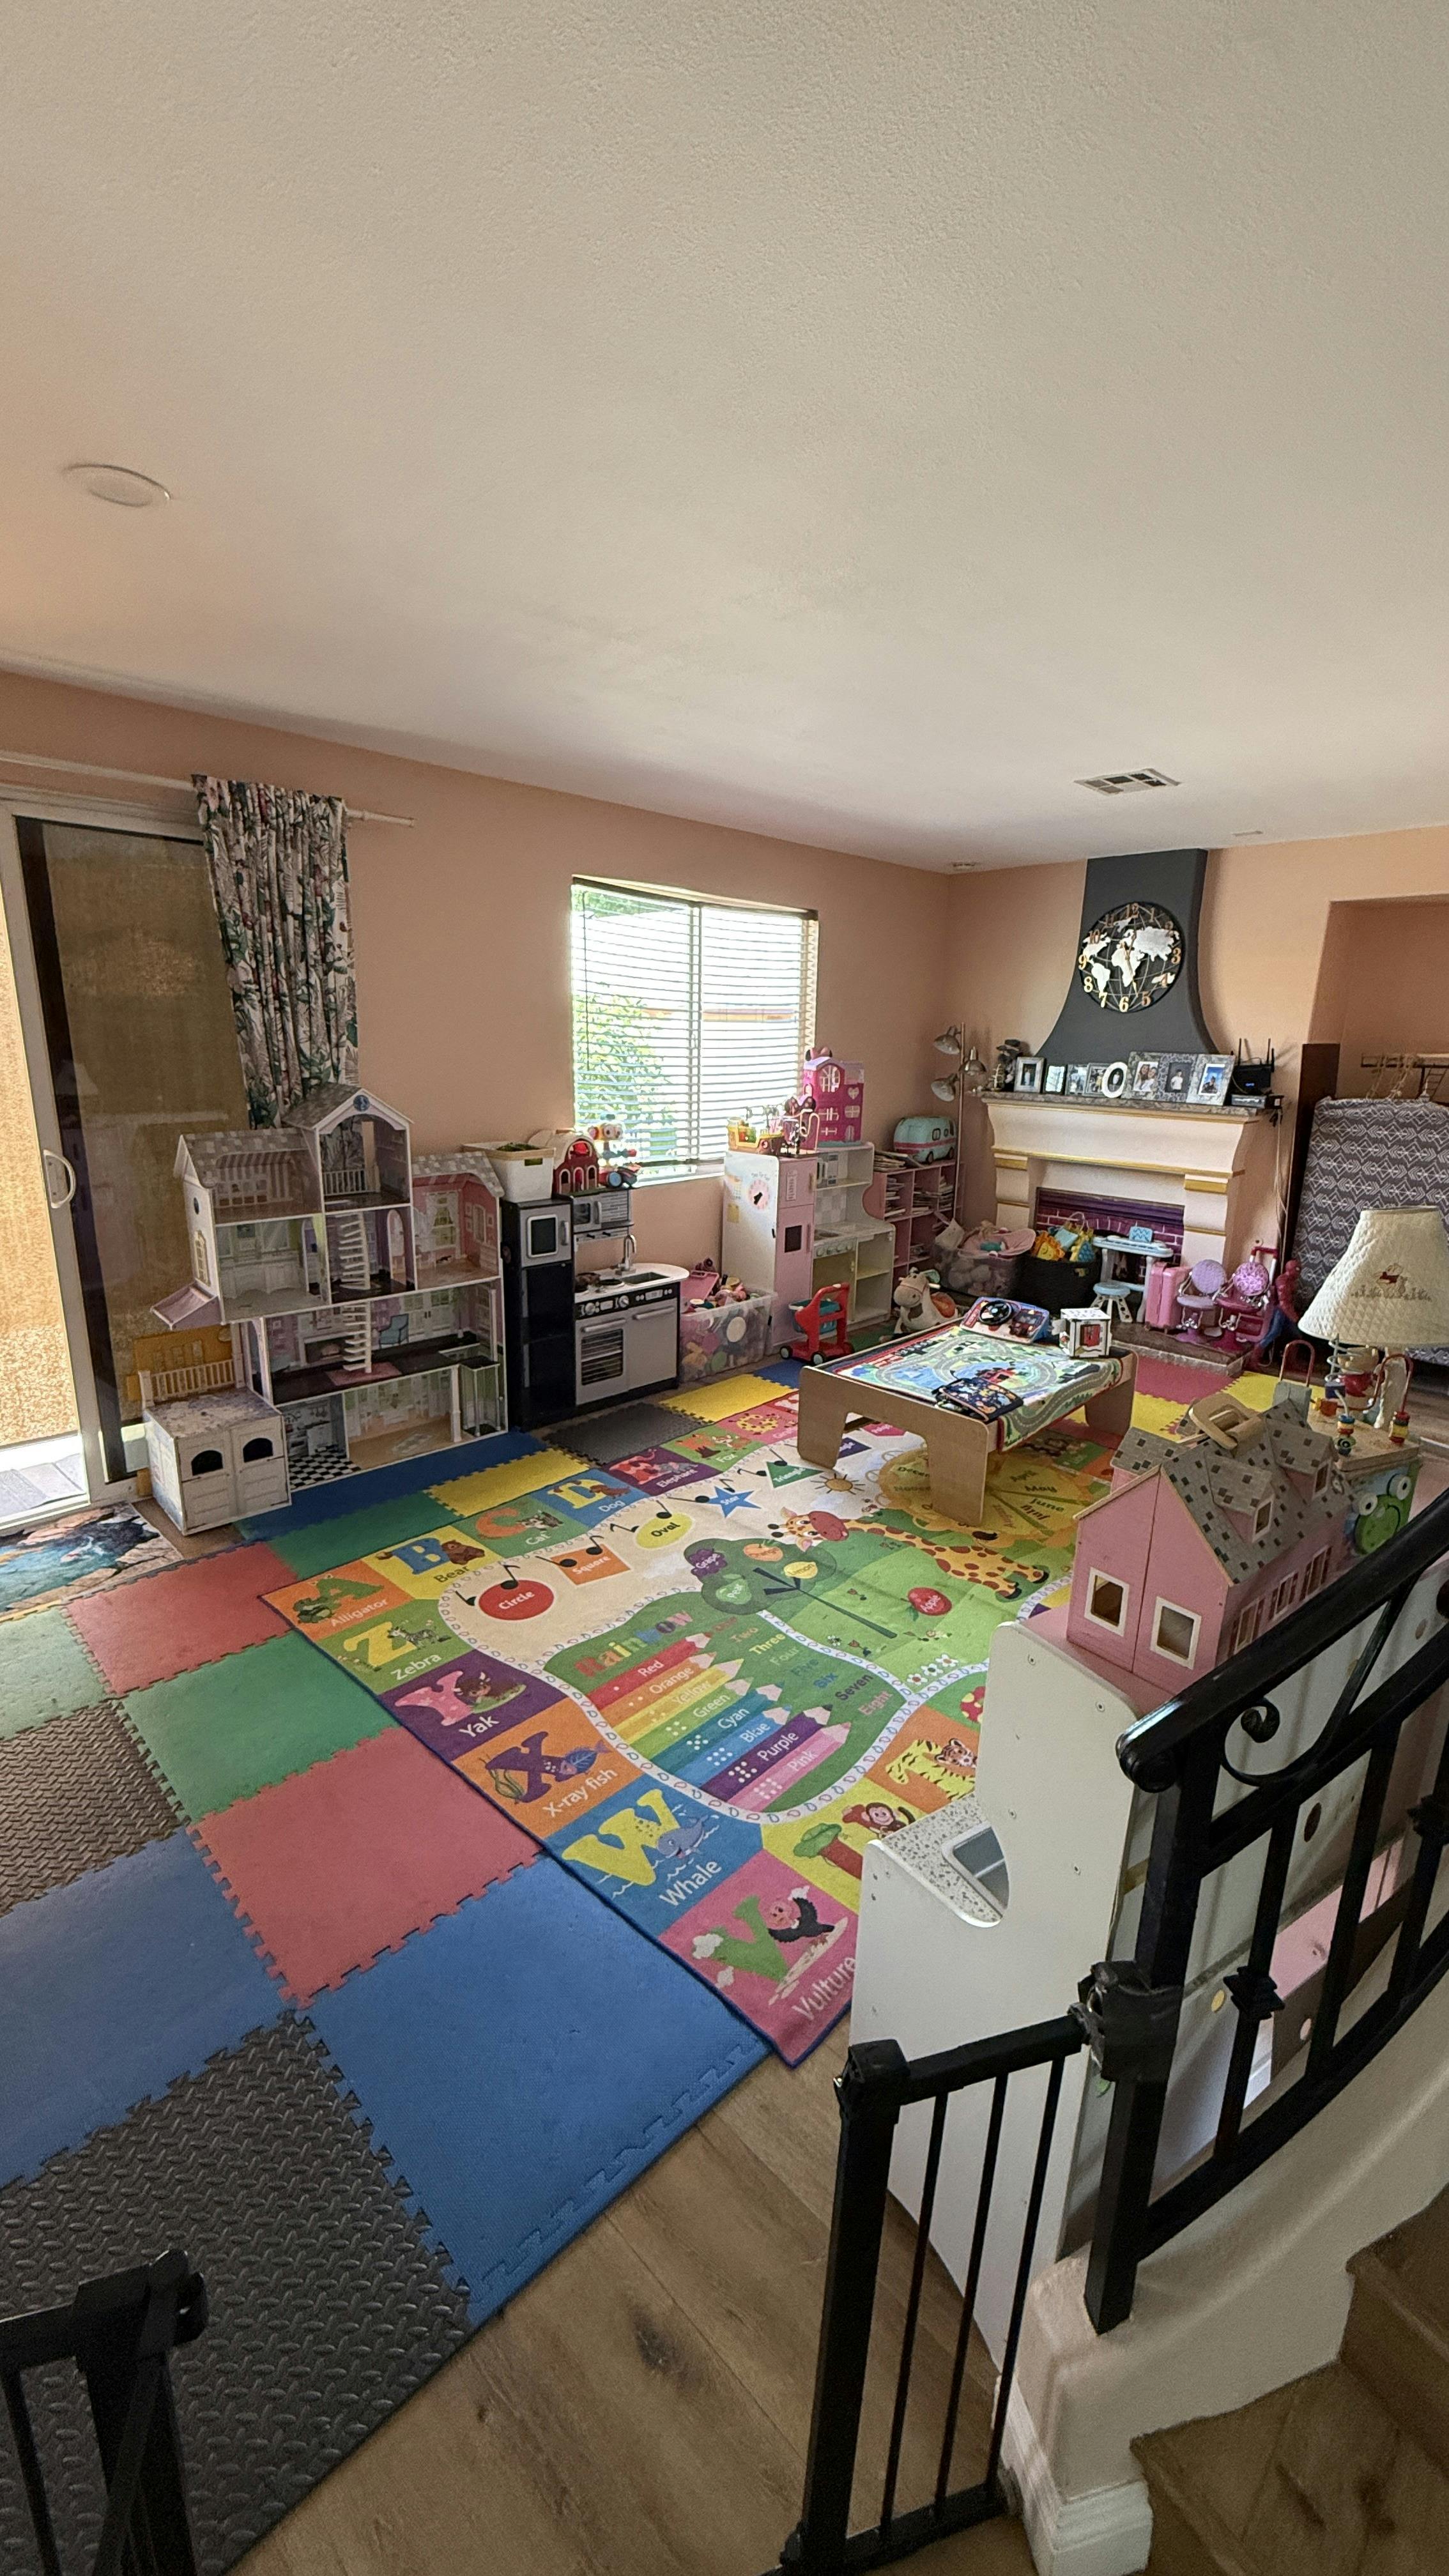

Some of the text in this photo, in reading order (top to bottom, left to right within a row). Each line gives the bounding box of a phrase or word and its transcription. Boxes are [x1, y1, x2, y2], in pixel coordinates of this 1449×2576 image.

[1126, 903, 1140, 919] 12
[1149, 907, 1156, 923] 1
[1088, 930, 1100, 944] 10
[1078, 954, 1087, 970] 9
[1172, 947, 1181, 964] 3
[1084, 976, 1093, 992] 8
[1099, 992, 1108, 1008] 7
[1119, 997, 1129, 1013] 6
[1141, 992, 1151, 1007] 5
[717, 1452, 738, 1464] Fox
[656, 1468, 698, 1488] Elephant
[1024, 1485, 1058, 1494] May
[598, 1499, 626, 1513] Dog
[1029, 1498, 1065, 1512] June
[475, 1507, 526, 1539] C
[650, 1521, 681, 1538] Oval
[525, 1529, 552, 1545] Cat
[392, 1537, 451, 1575] B
[572, 1555, 611, 1575] Square
[433, 1565, 471, 1583] Bear
[498, 1590, 535, 1611] Circle
[920, 1595, 940, 1613] Apple
[330, 1597, 389, 1628] Alligator
[343, 1621, 418, 1667] Z
[748, 1632, 786, 1655] Three
[390, 1654, 443, 1681] Zebra
[637, 1660, 664, 1677] Red
[649, 1666, 694, 1694] Orange
[835, 1673, 874, 1701] Seven
[394, 1670, 476, 1726] Y
[672, 1680, 712, 1706] Yellow
[693, 1693, 731, 1718] Green
[459, 1715, 500, 1738] Yak
[717, 1708, 751, 1729] Cyan
[739, 1722, 771, 1744] Blue
[757, 1731, 800, 1762] Purple
[485, 1731, 576, 1804] X
[786, 1750, 820, 1772] Pink
[542, 1767, 619, 1818] X-ray fish
[561, 1788, 681, 1887] W
[659, 1860, 723, 1907] Whale
[791, 1956, 857, 2021] Vulture
